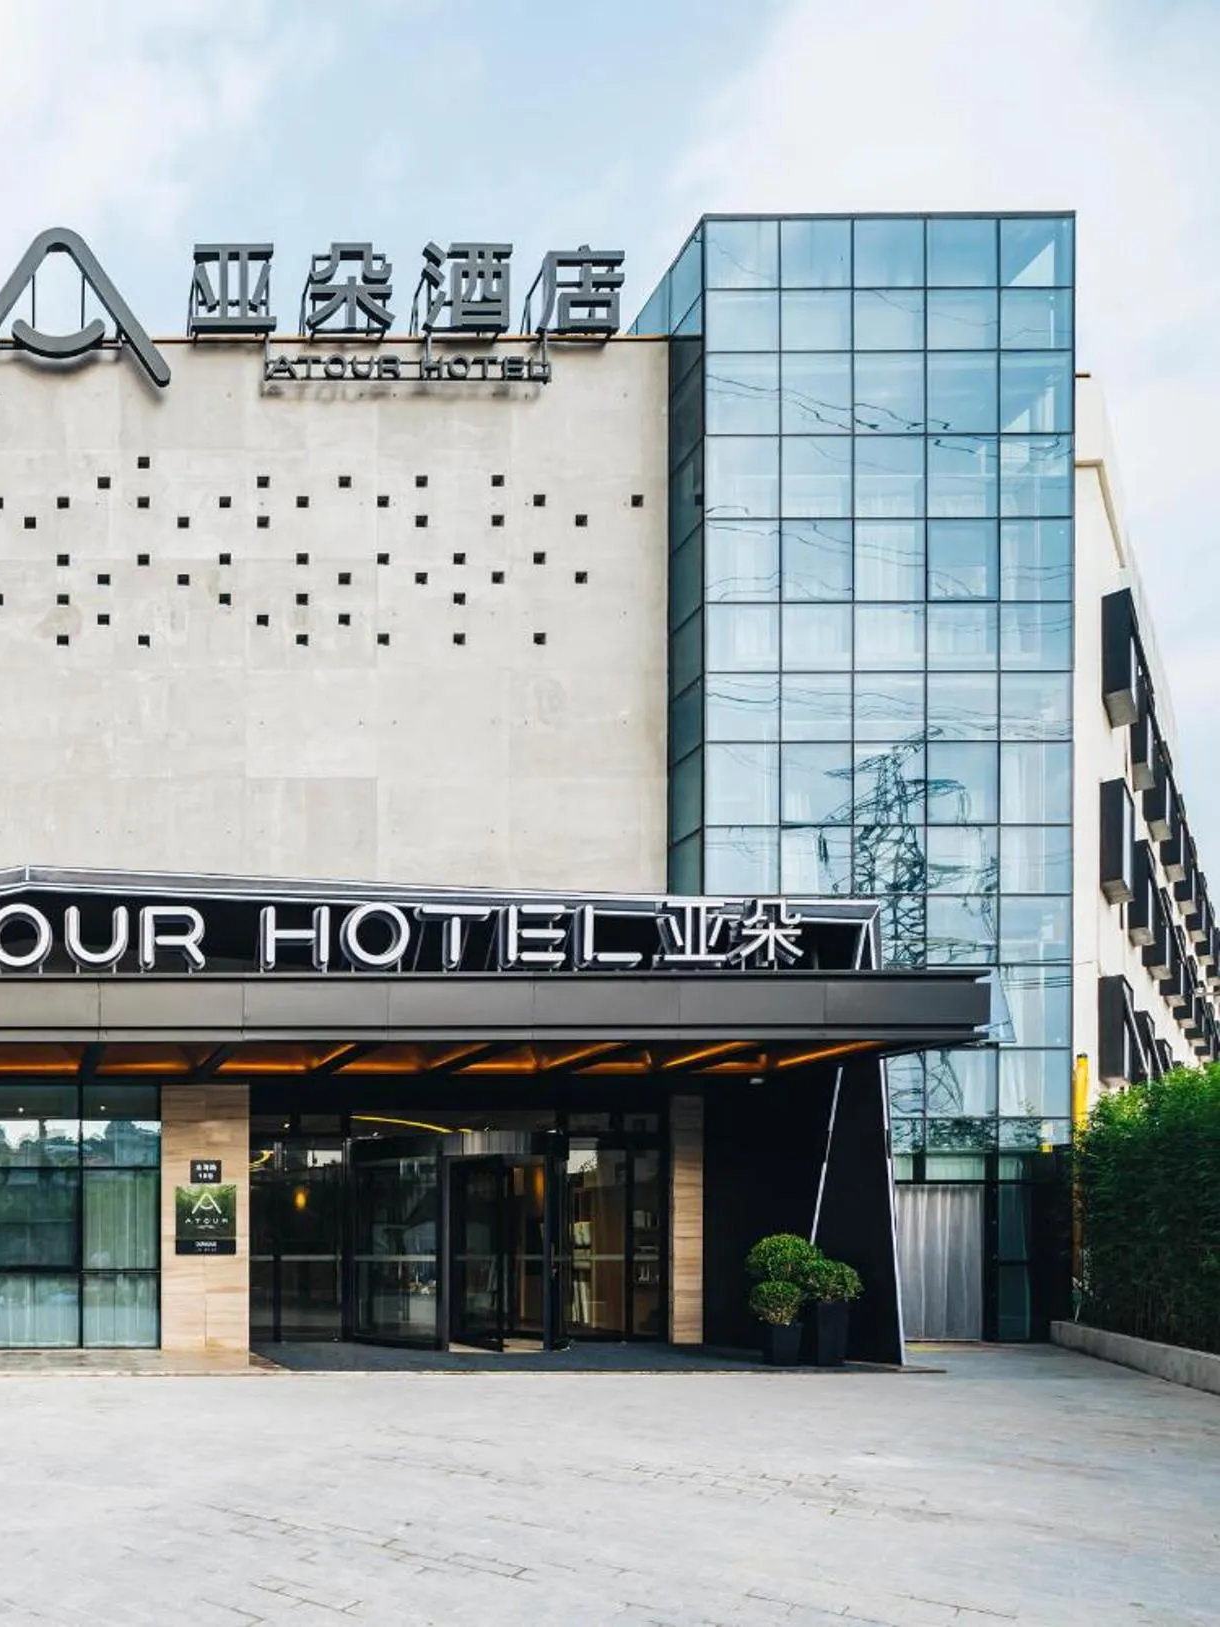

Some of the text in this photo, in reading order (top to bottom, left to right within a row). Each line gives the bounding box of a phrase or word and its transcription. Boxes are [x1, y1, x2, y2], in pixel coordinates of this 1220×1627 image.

[191, 241, 626, 336] 亚朵酒店
[266, 353, 551, 382] ATOUR HOTEL
[259, 902, 644, 970] HOTEL
[654, 899, 806, 968] 亚朵
[184, 1217, 229, 1225] ATOUR
